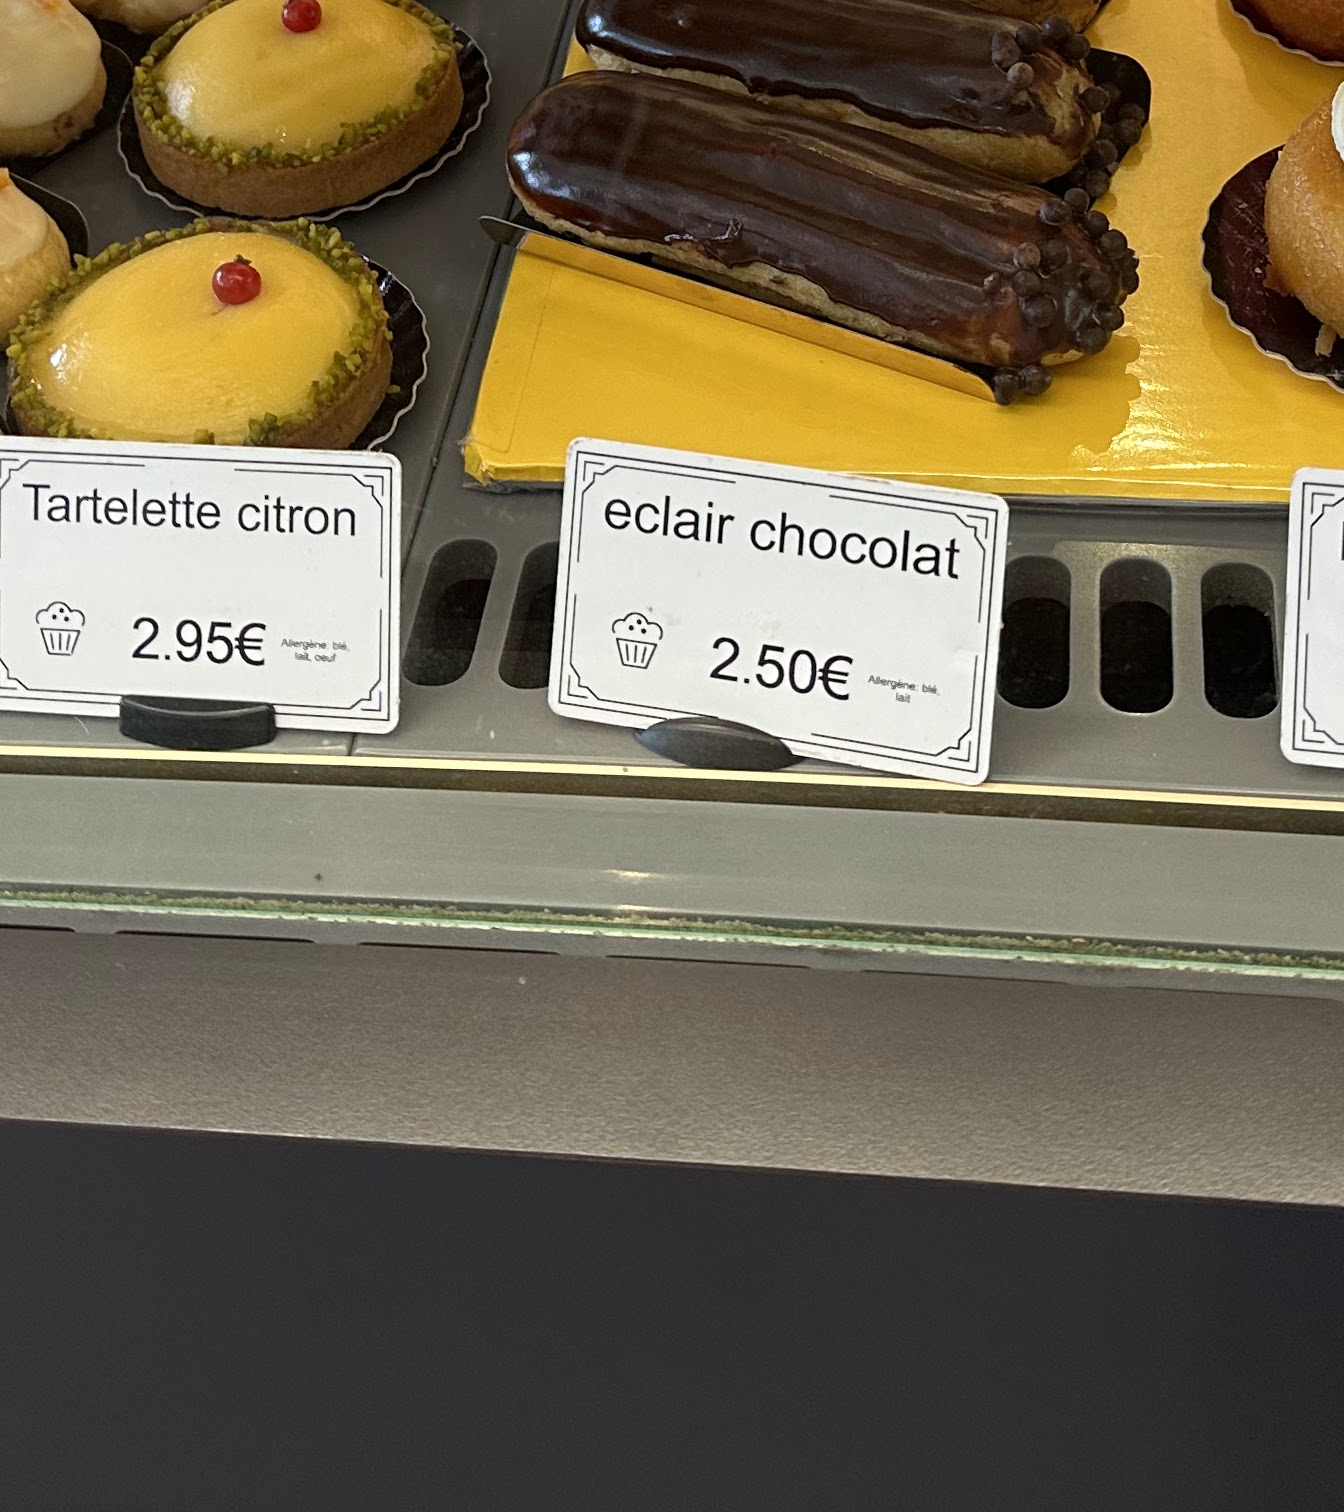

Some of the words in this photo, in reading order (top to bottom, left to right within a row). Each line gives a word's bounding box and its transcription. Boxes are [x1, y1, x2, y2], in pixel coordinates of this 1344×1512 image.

[22, 483, 221, 529] Tartelette
[238, 494, 357, 536] citron
[604, 495, 734, 545] eclair
[749, 511, 961, 580] chocolat
[131, 617, 267, 666] 2.95€
[709, 636, 854, 701] 2.50€
